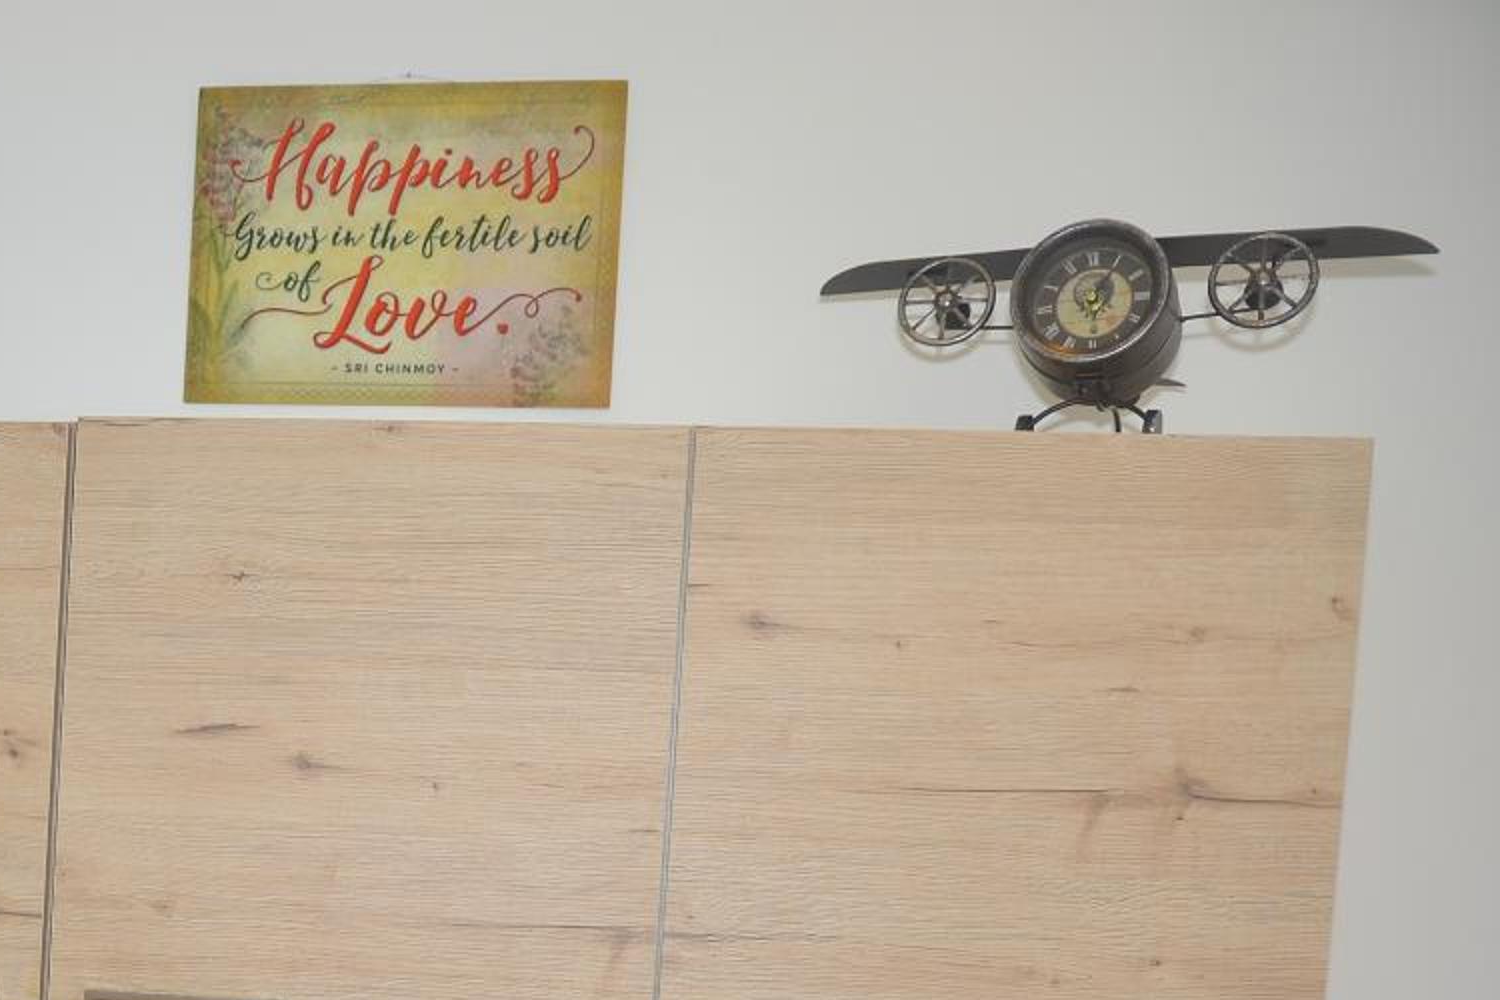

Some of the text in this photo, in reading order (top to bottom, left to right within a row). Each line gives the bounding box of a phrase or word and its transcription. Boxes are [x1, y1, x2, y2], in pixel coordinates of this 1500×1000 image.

[229, 117, 595, 217] Happiness
[228, 211, 592, 261] Grows in the fertile soil
[255, 260, 322, 303] of
[344, 362, 446, 375] SRI CHINMOY
